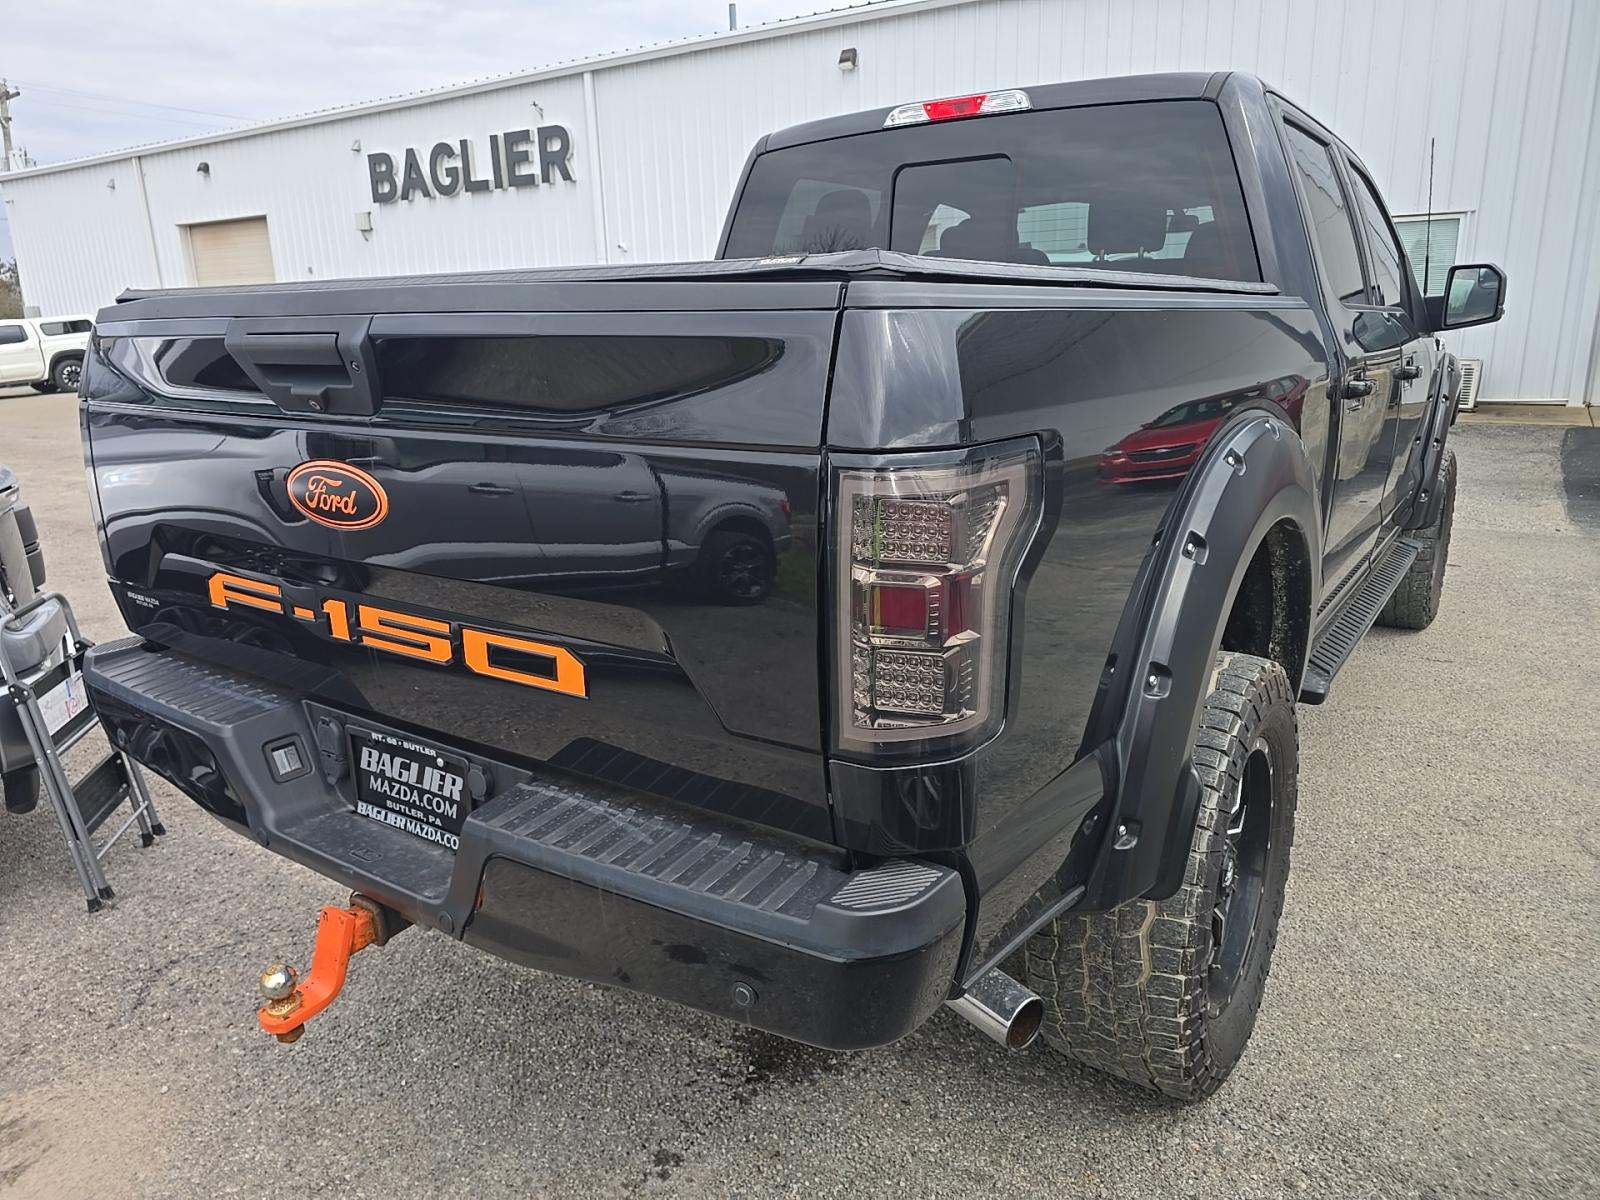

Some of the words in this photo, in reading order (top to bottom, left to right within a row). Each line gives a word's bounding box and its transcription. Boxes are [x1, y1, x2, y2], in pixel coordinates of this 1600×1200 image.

[367, 125, 576, 203] BAGLIER
[305, 475, 358, 515] Ford
[208, 571, 590, 700] F-150
[403, 741, 437, 758] BUTLER
[360, 747, 463, 800] BAGLIER
[357, 801, 405, 830] BAGLIER
[370, 775, 457, 819] MAZDA.COM
[428, 815, 442, 827] PA
